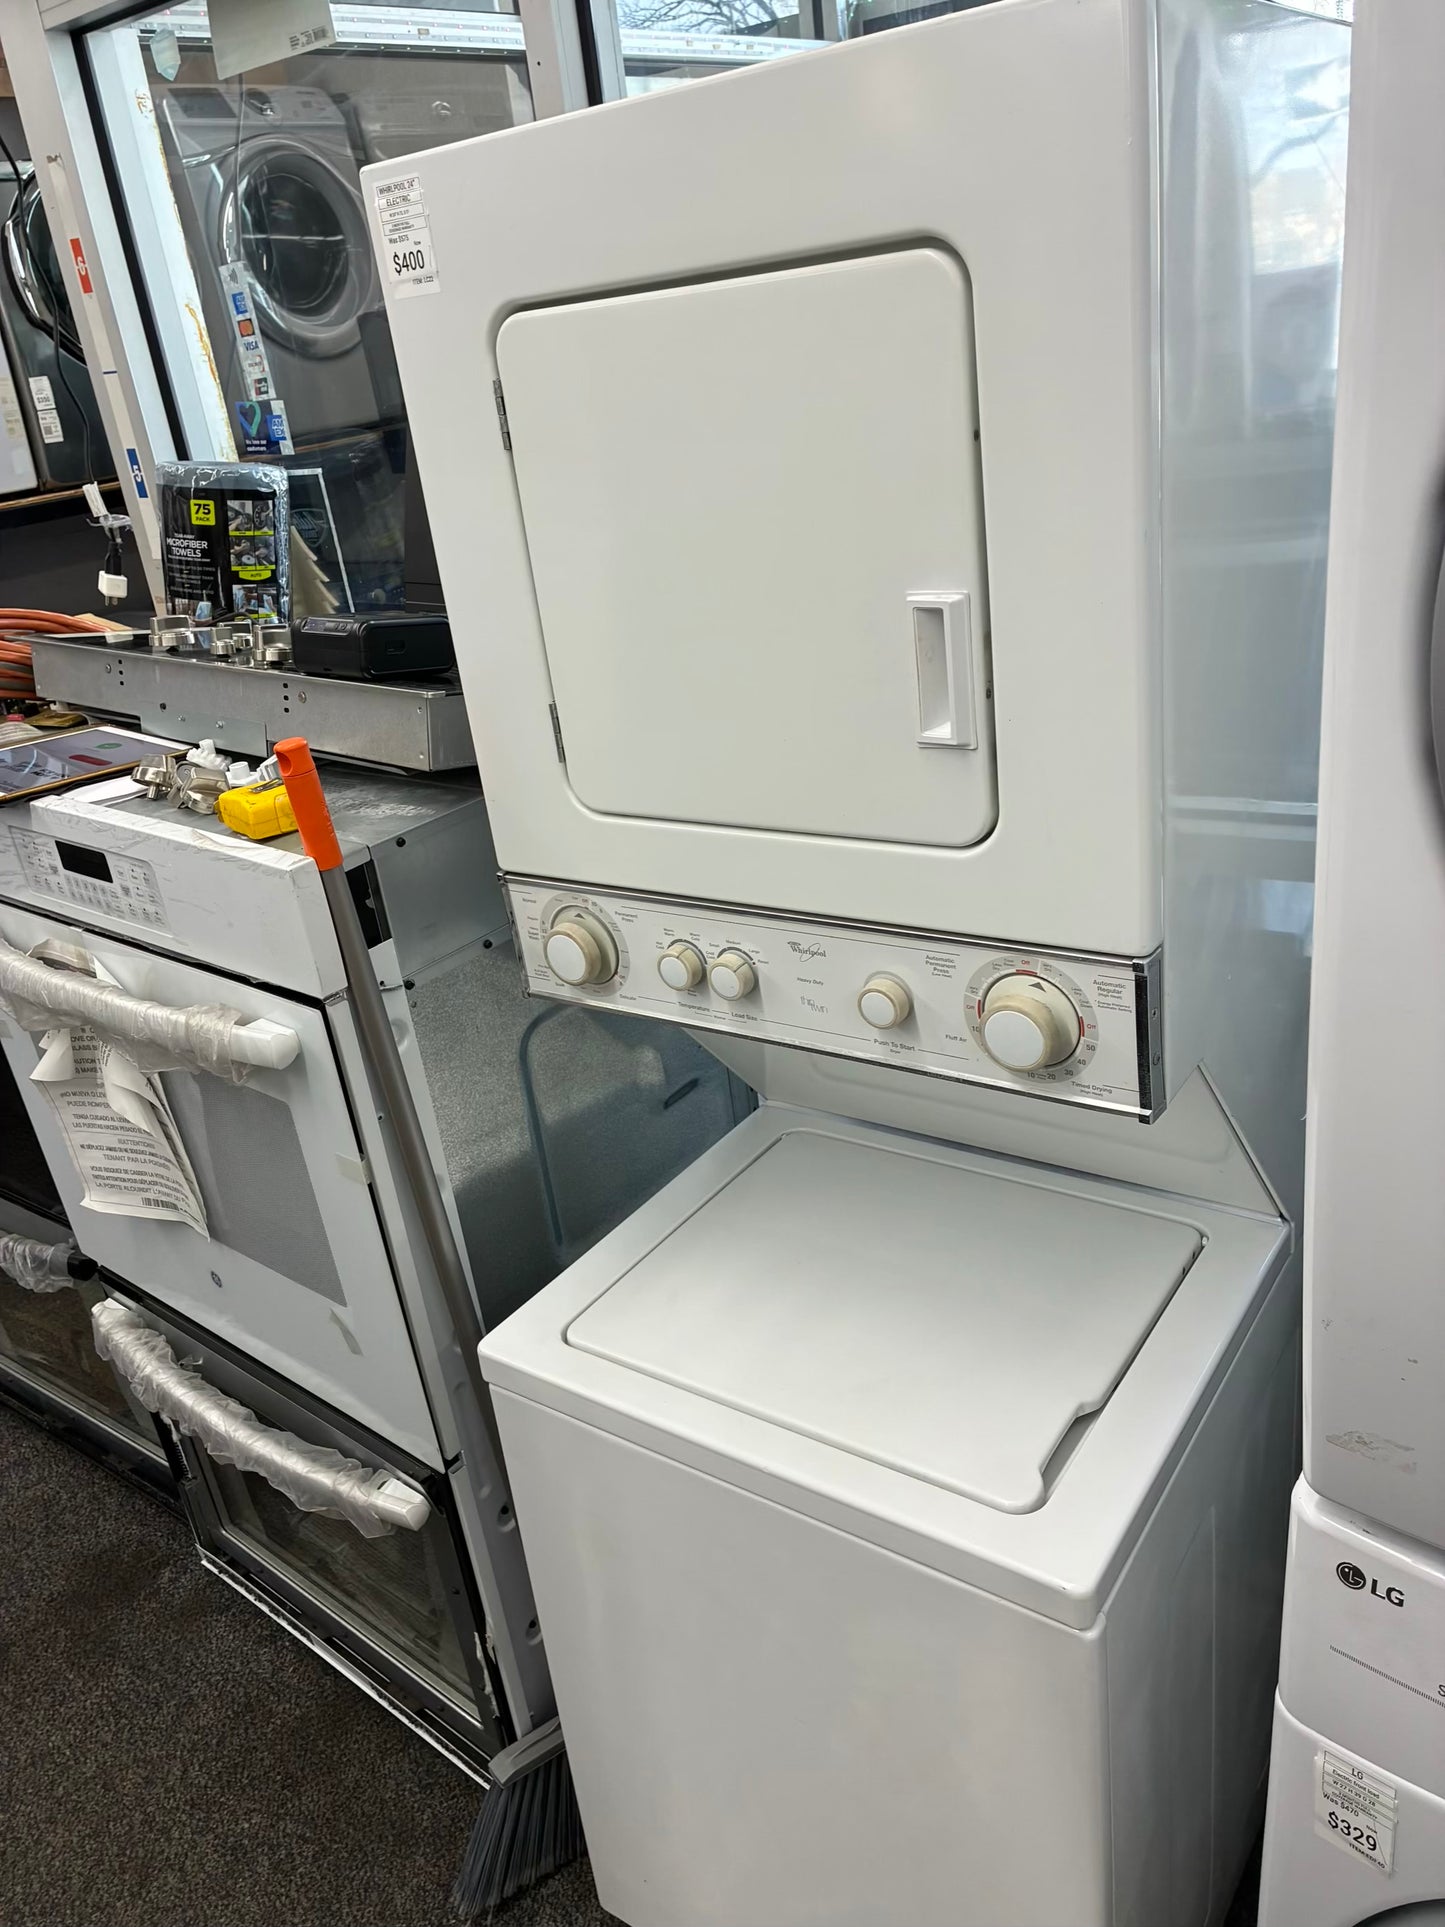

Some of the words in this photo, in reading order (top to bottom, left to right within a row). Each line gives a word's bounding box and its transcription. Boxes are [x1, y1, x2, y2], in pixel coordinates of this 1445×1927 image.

[378, 182, 407, 195] WHIRLPOOL
[386, 194, 411, 207] ELECTRIC
[388, 237, 398, 245] Was
[393, 250, 425, 276] $400
[244, 340, 259, 351] VISA
[194, 504, 211, 515] 75
[166, 538, 208, 549] MICROFIBER
[171, 547, 202, 558] TOWELS
[790, 944, 827, 958] Whirlpool
[925, 960, 957, 970] Permanent
[926, 955, 956, 964] Automatic
[933, 967, 950, 975] Press
[1093, 980, 1127, 990] Automatic
[1097, 986, 1123, 994] Regular
[678, 1002, 711, 1012] Temperature
[972, 1025, 980, 1033] 10
[874, 1038, 890, 1046] Push
[899, 1043, 916, 1052] Start
[1071, 1081, 1091, 1090] Timed
[1092, 1085, 1113, 1094] Drying
[103, 1154, 126, 1162] TENANT
[104, 1183, 122, 1191] PORTE
[1370, 1578, 1405, 1608] LG
[1352, 1768, 1364, 1780] LG
[1333, 1769, 1353, 1784] Electric
[1353, 1781, 1367, 1791] front
[1368, 1789, 1380, 1799] load
[1323, 1792, 1339, 1806] Was
[1341, 1802, 1359, 1817] $470
[1328, 1811, 1377, 1852] $329
